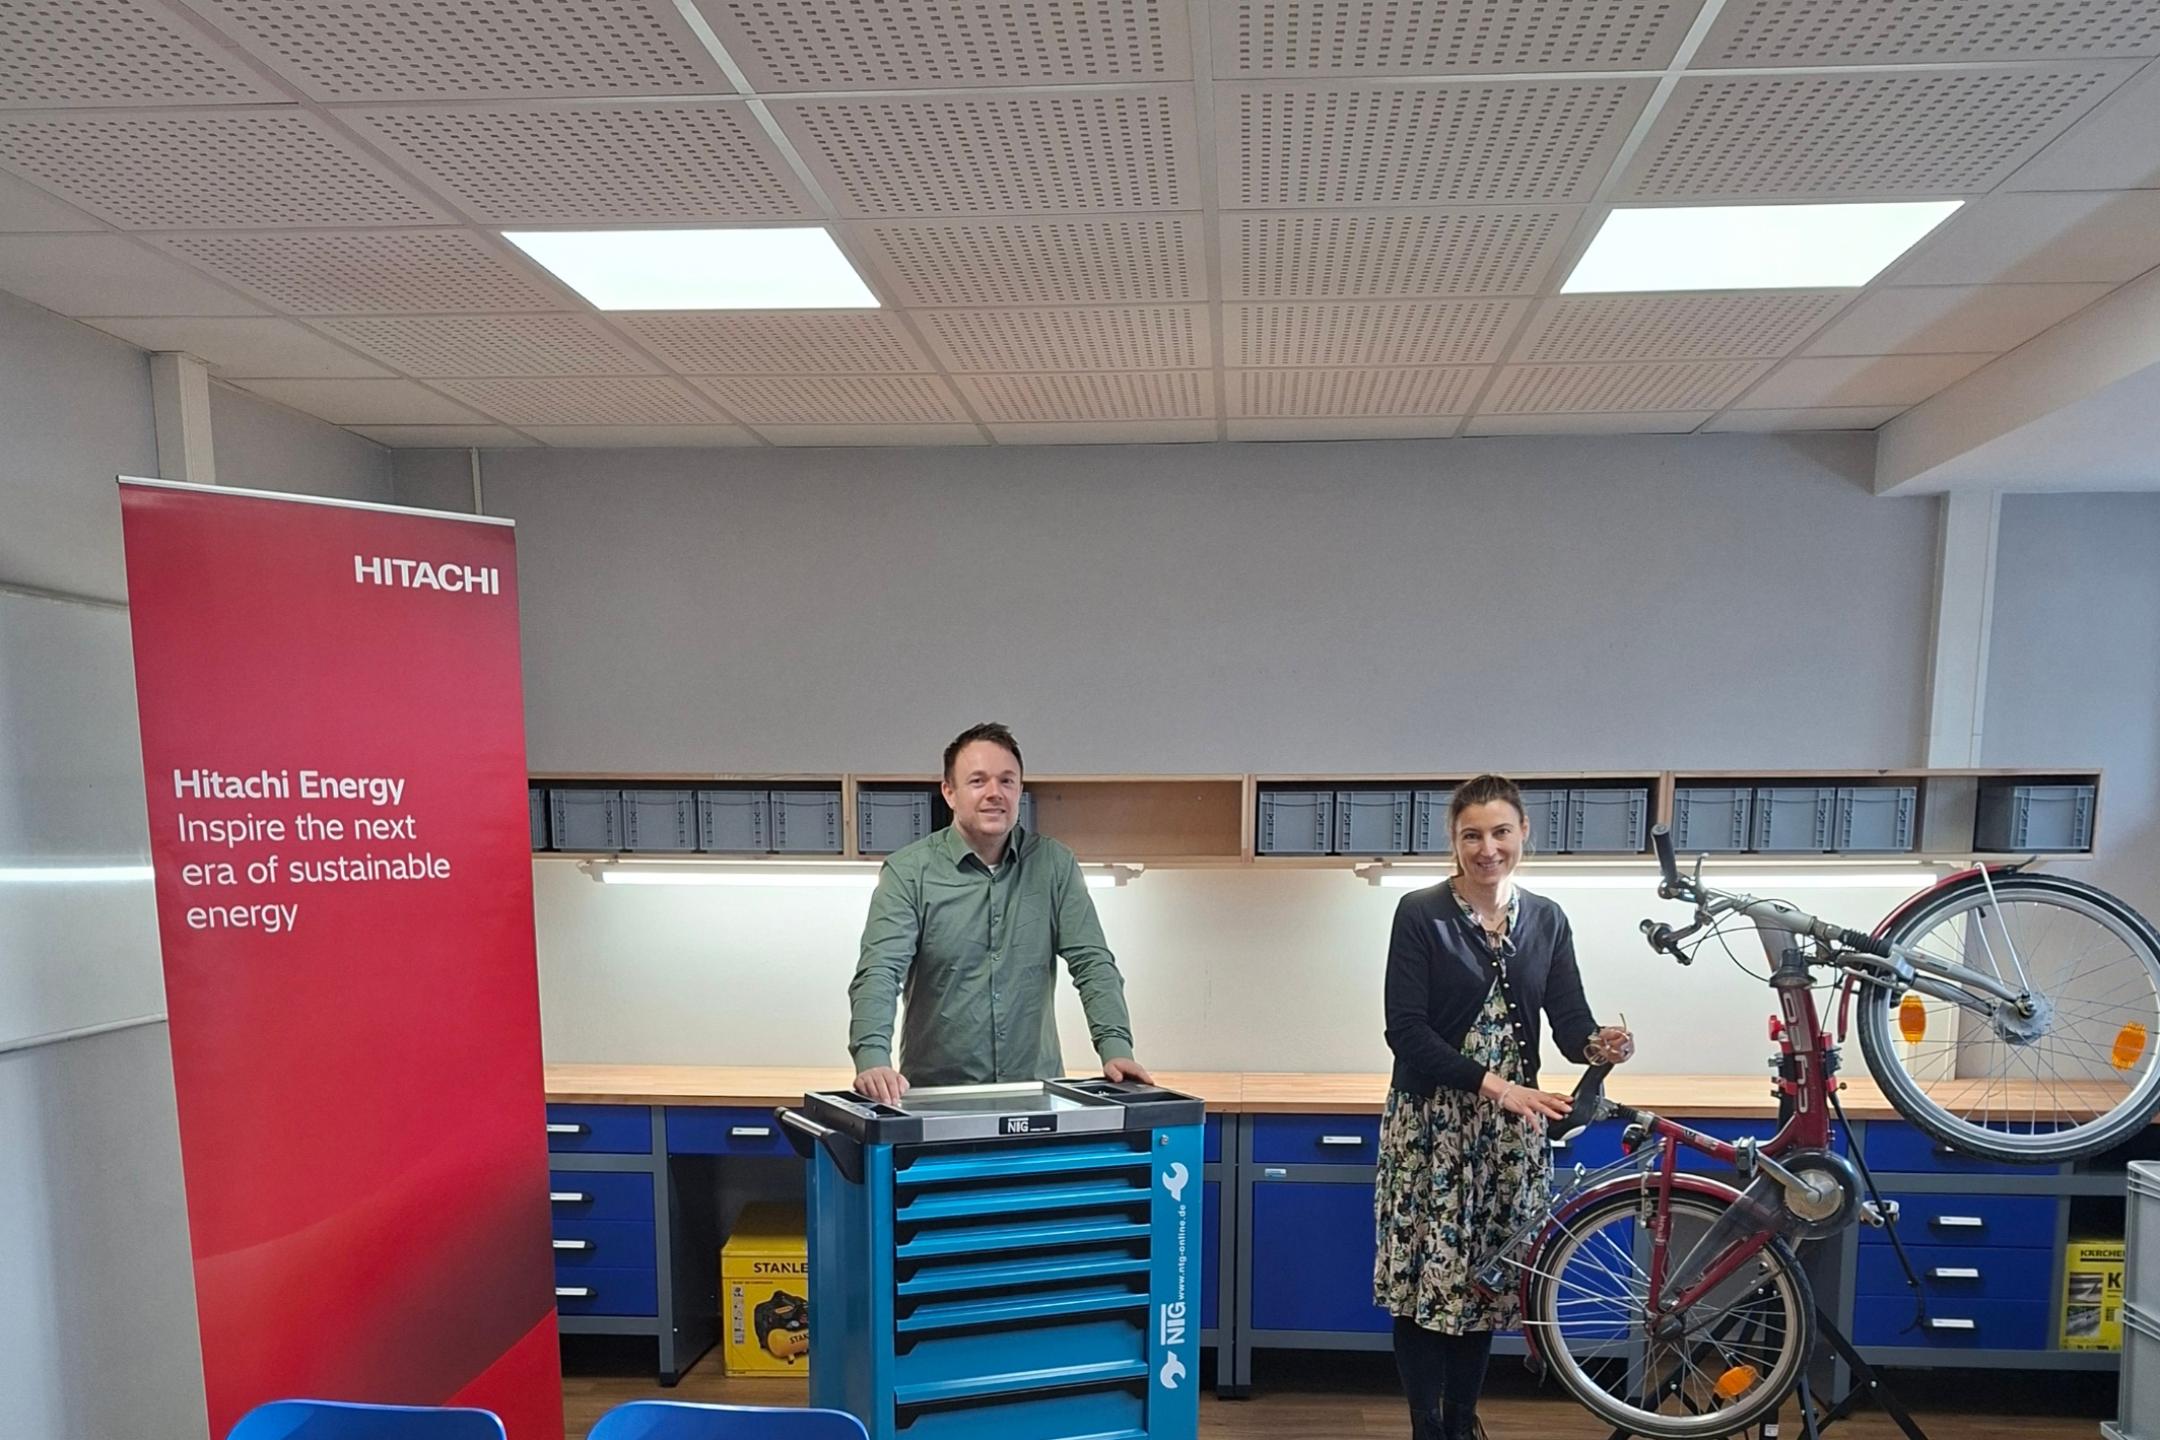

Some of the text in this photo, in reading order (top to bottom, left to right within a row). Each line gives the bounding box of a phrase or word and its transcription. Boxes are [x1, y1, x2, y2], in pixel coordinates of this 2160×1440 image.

[355, 555, 499, 595] HITACHI
[174, 769, 404, 805] Hitachi Energy
[179, 813, 416, 848] Inspire the next
[183, 853, 450, 885] era of sustainable
[187, 904, 297, 932] energy
[1177, 1204, 1188, 1300] www.ntg-online.de
